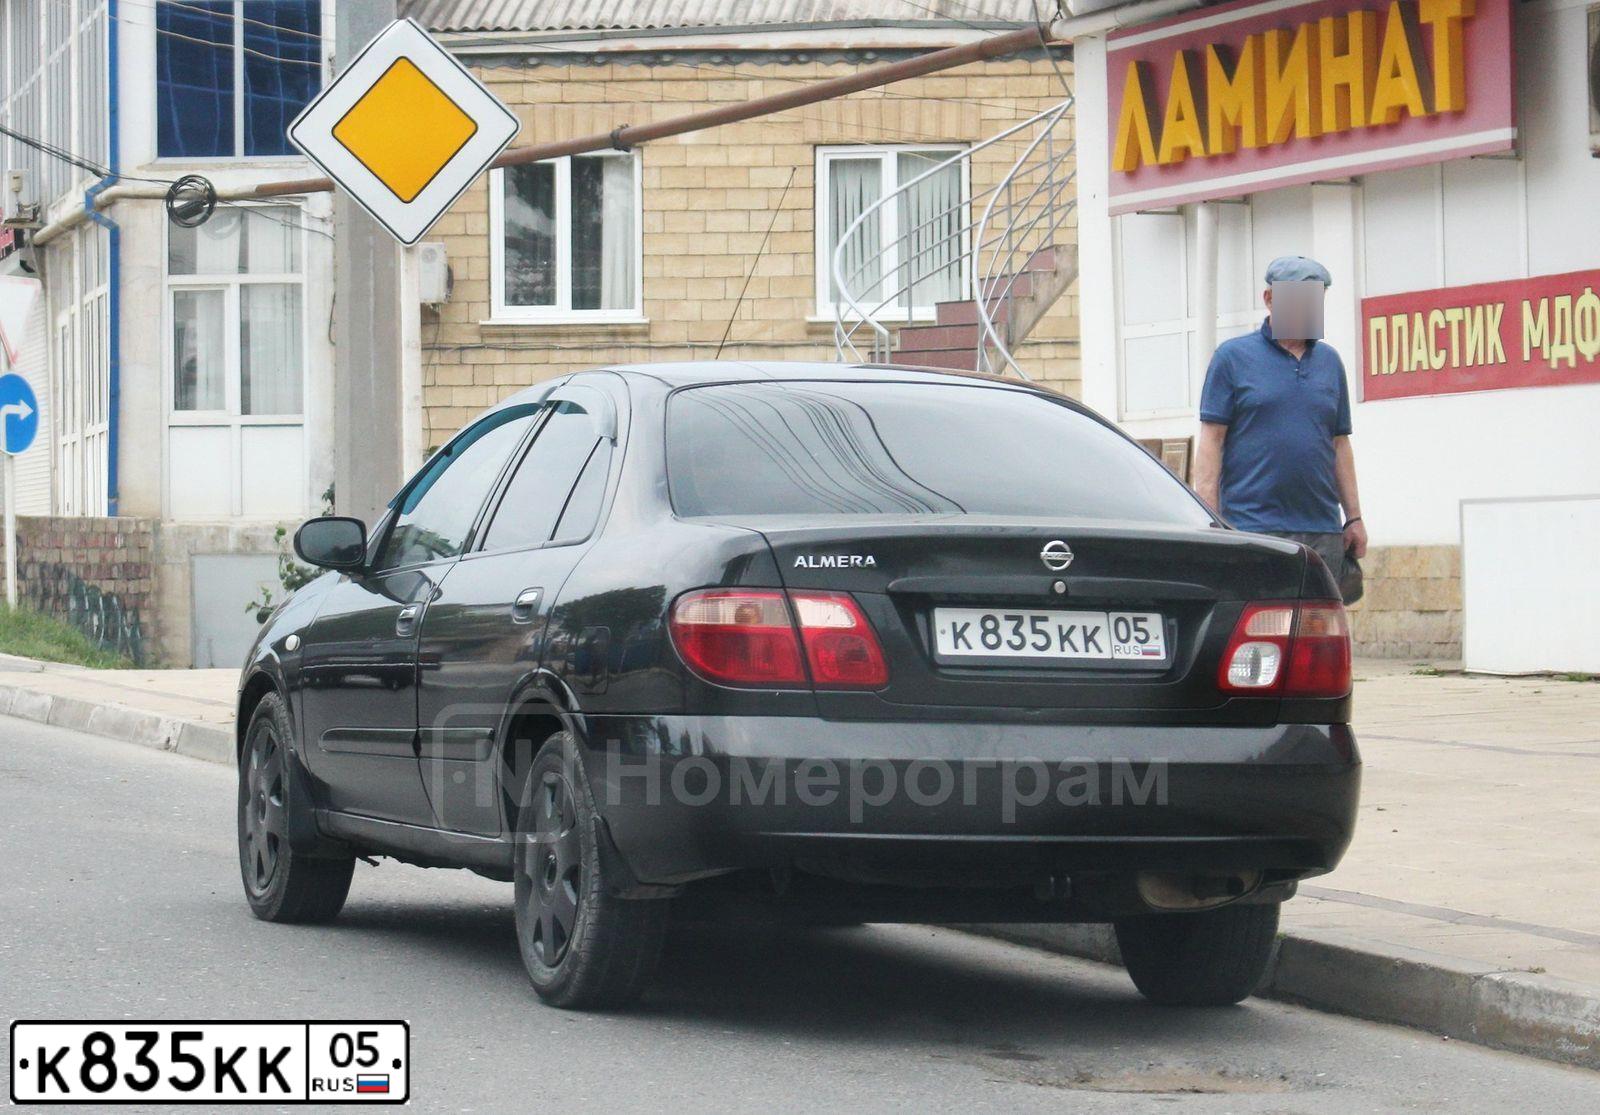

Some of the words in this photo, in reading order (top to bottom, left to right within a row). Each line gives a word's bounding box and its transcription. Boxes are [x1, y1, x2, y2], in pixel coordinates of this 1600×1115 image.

[1111, 0, 1475, 172] ЛАМИНАТ
[1369, 303, 1507, 376] ПЛАСТИК
[1522, 286, 1600, 369] МДФ
[794, 555, 877, 568] ALMERA
[1113, 616, 1150, 644] 05
[1114, 645, 1141, 655] RUS
